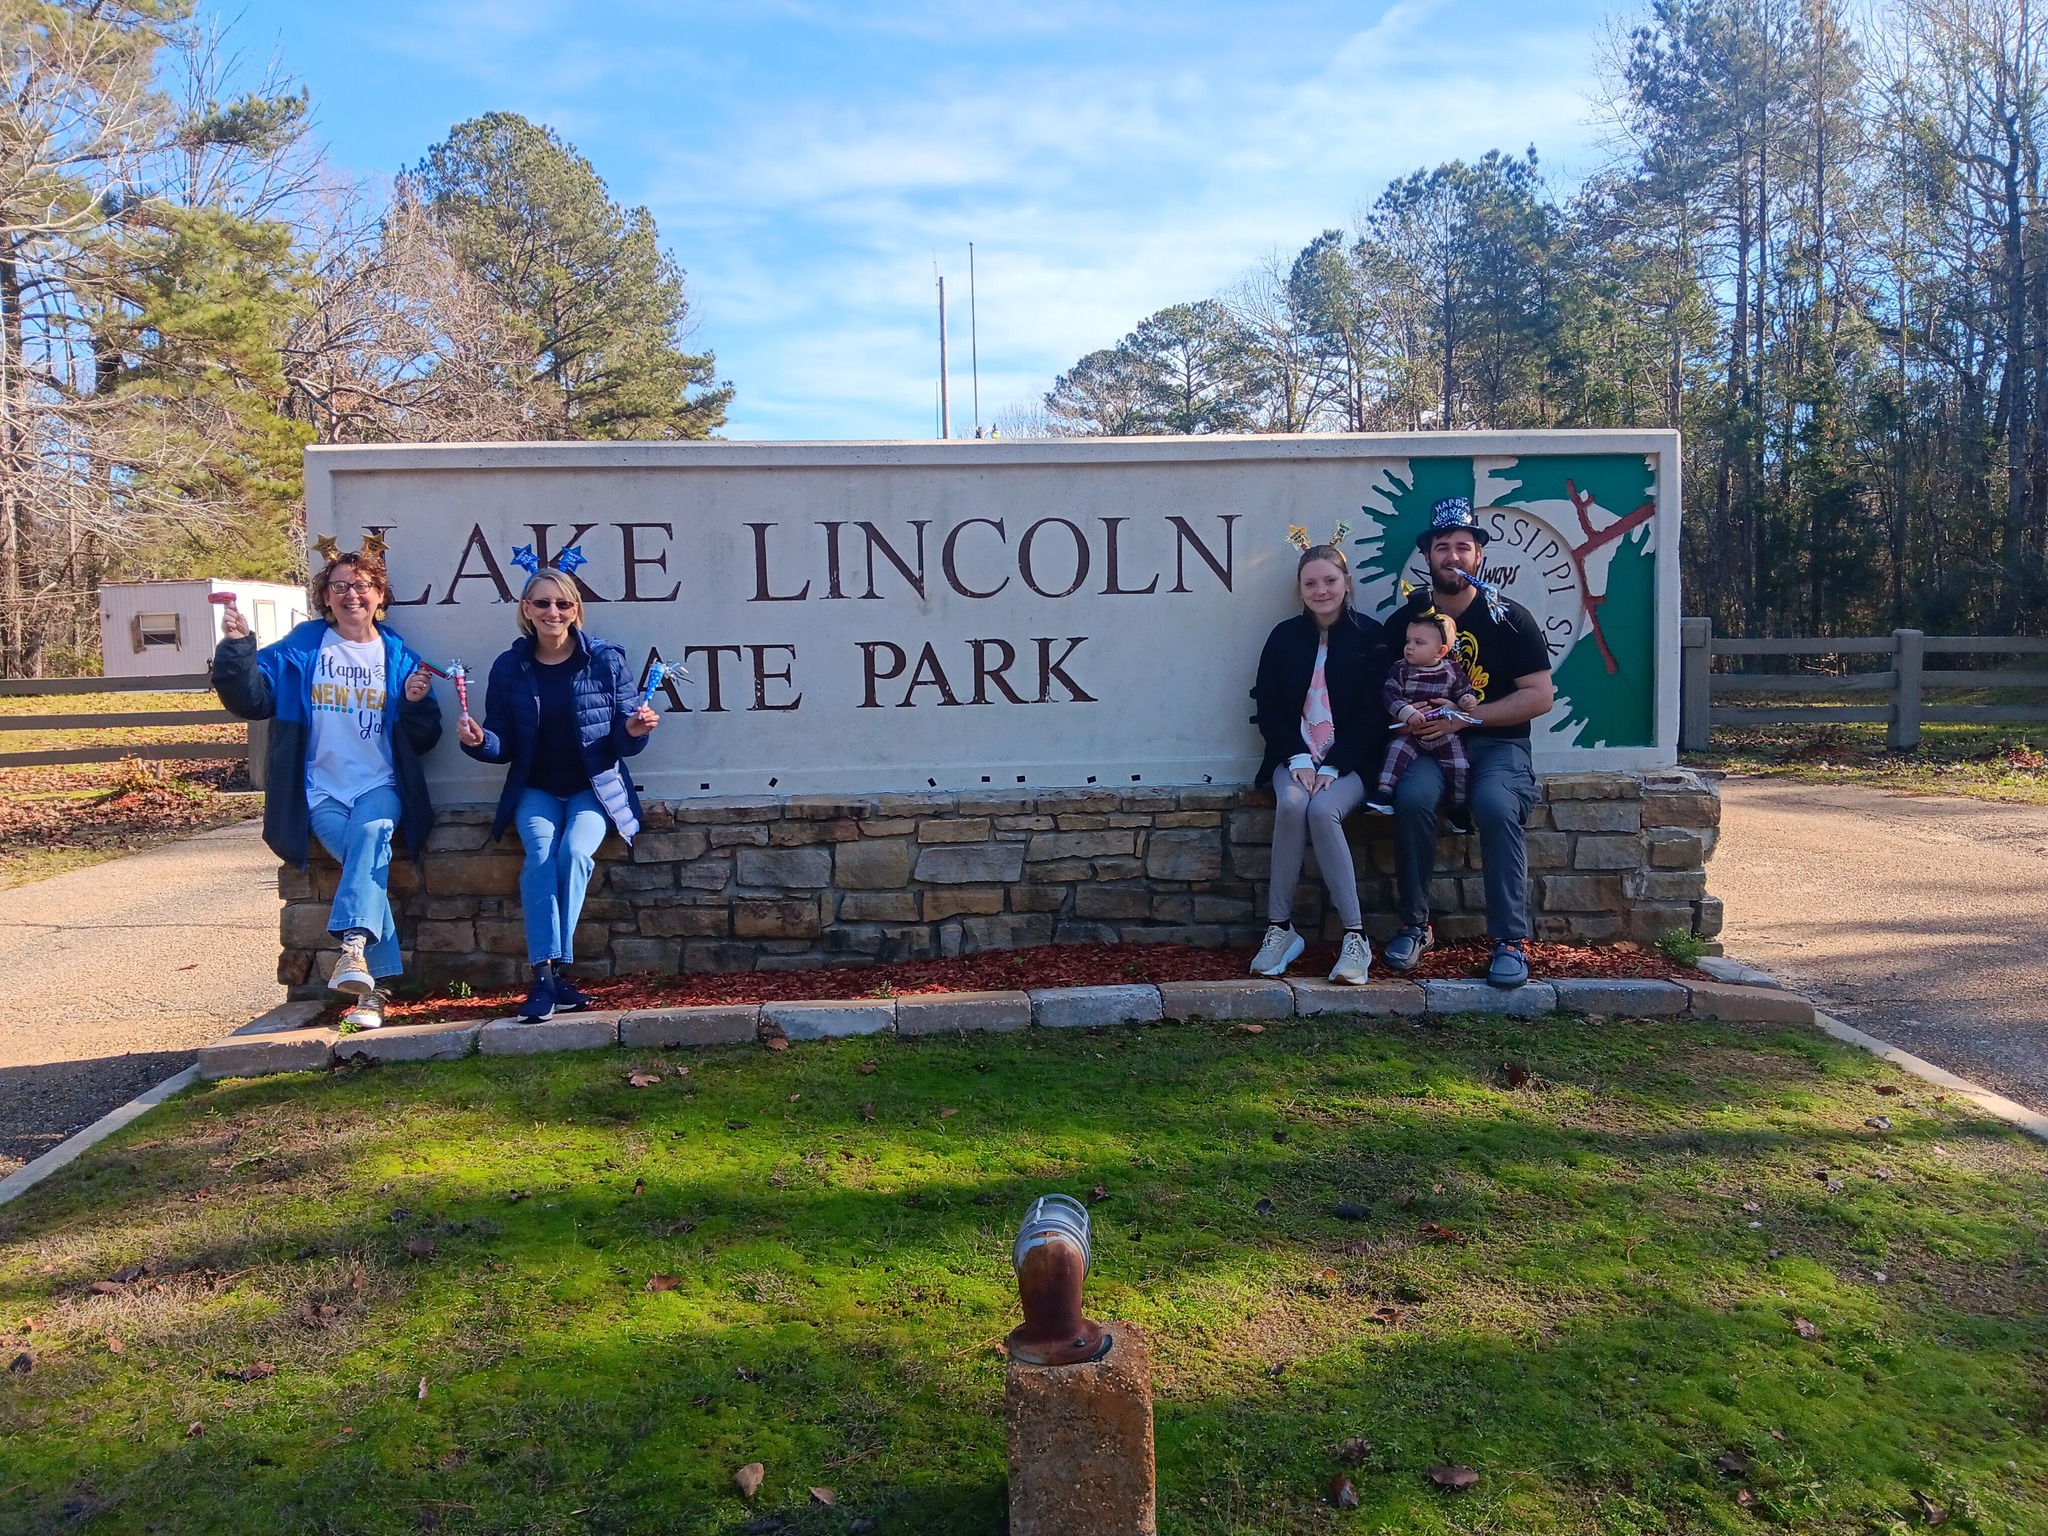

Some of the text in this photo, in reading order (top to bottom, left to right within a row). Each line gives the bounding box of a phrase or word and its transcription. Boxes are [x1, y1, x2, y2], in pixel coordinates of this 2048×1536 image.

[743, 513, 1243, 602] LINCOLN
[1475, 556, 1521, 590] lways
[317, 654, 372, 687] Happy
[636, 636, 1099, 713] ATE PARK
[312, 683, 387, 710] NEW YEA
[359, 710, 383, 740] Y'a
